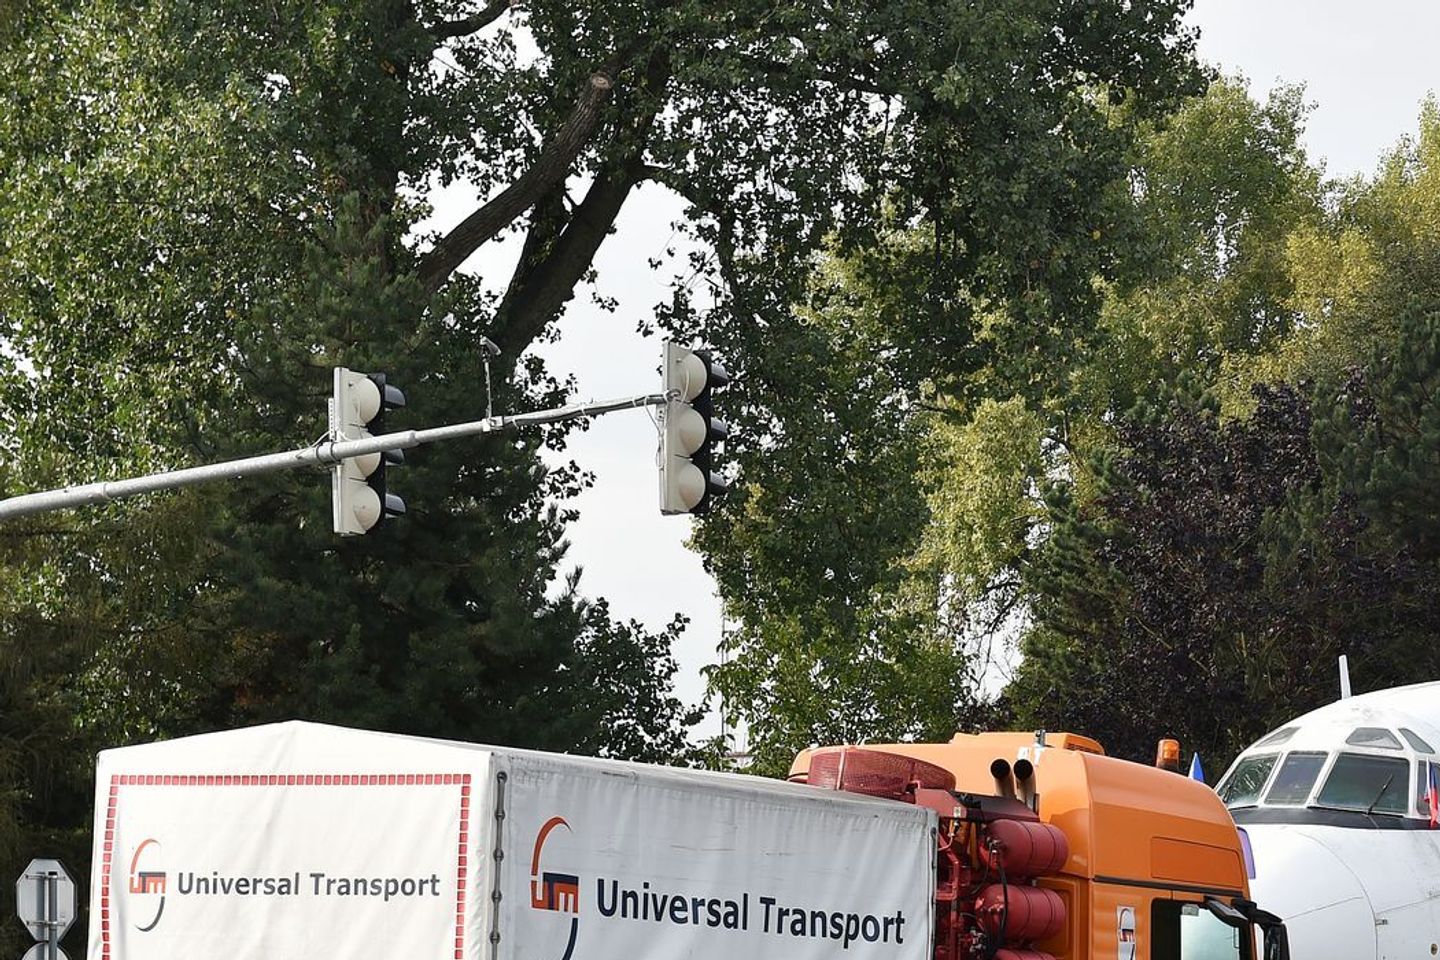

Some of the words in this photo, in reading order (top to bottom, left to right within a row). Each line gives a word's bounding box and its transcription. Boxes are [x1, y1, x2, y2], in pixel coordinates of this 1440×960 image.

[177, 871, 301, 897] Universal
[309, 872, 441, 902] Transport
[596, 877, 749, 931] Universal
[759, 896, 906, 949] Transport
